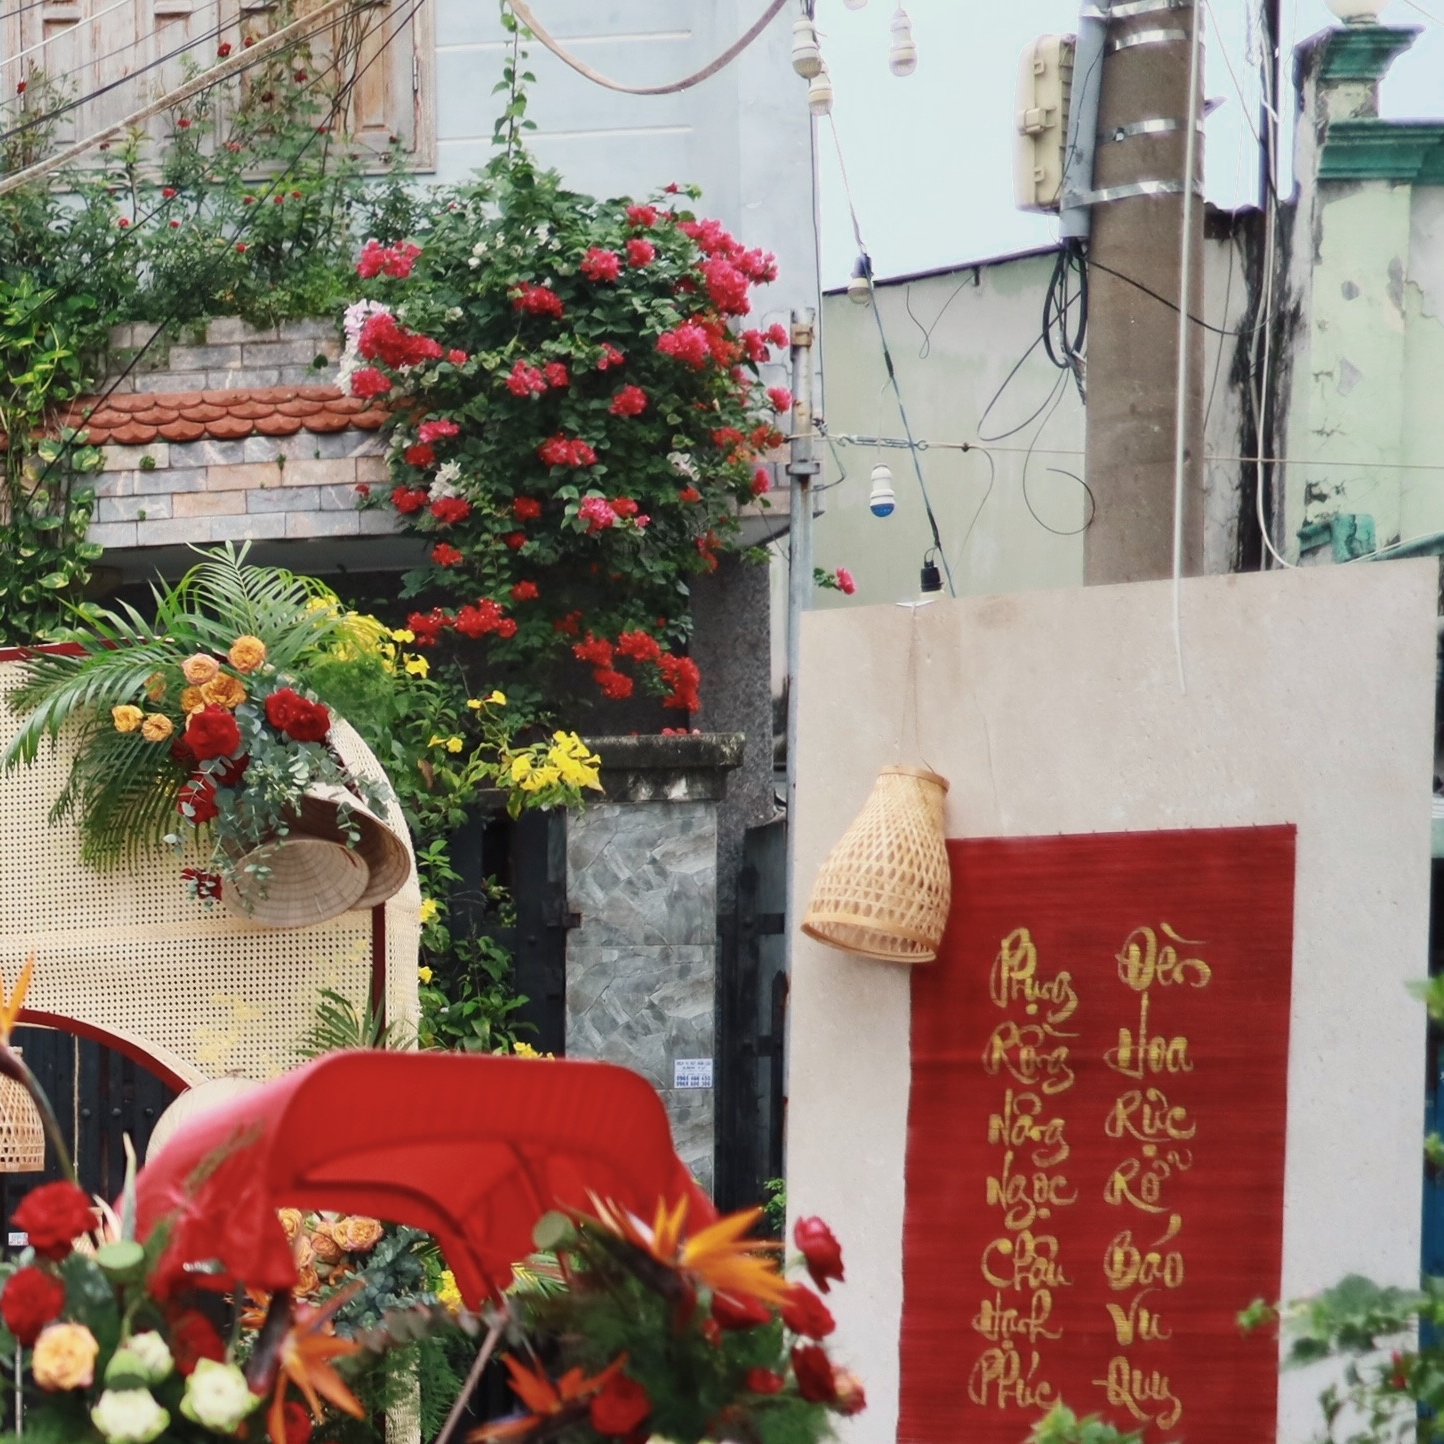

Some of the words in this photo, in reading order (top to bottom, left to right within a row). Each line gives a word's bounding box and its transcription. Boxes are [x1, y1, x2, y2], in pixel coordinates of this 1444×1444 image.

[982, 1021, 1080, 1094] Rồng
[1103, 991, 1193, 1079] Hoa
[987, 1150, 1078, 1230] Ngọc
[1106, 1288, 1173, 1346] Vu
[1092, 1356, 1182, 1430] Quy
